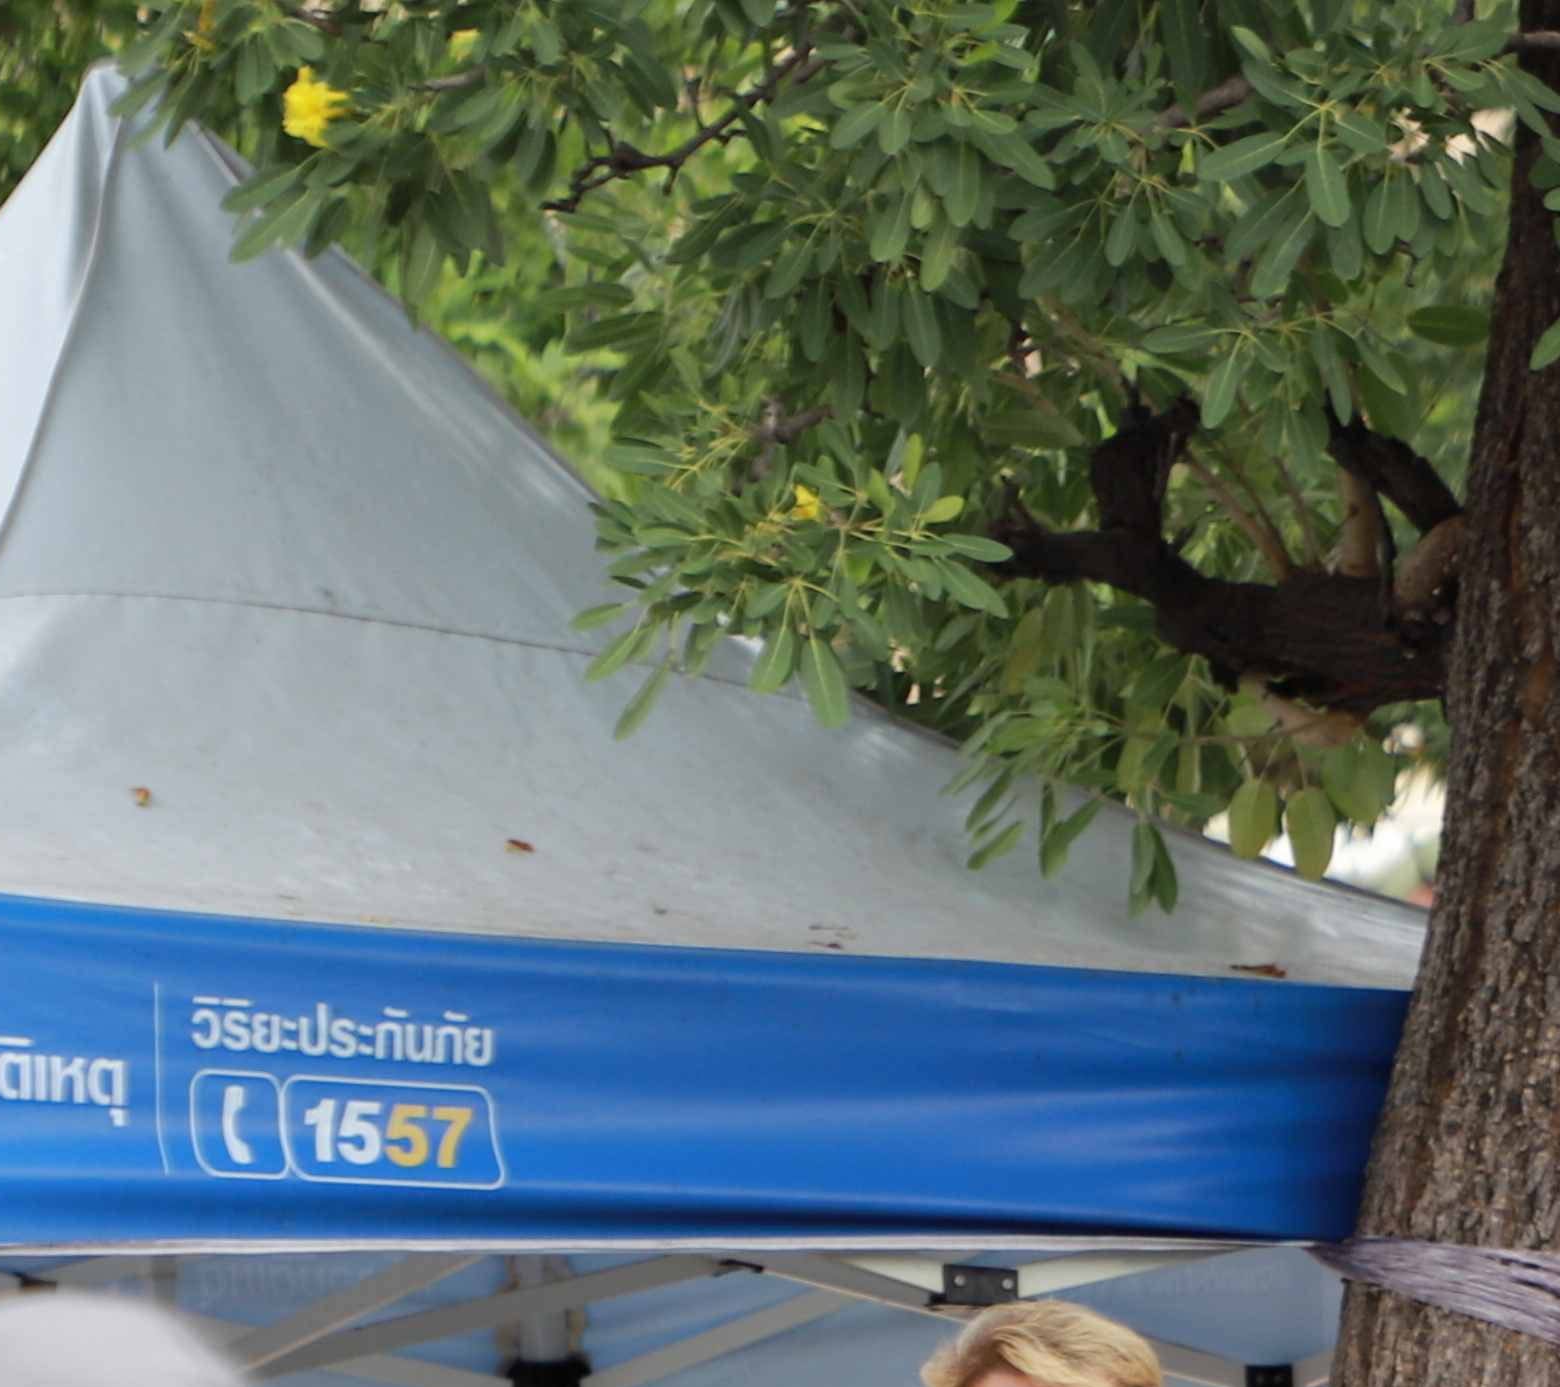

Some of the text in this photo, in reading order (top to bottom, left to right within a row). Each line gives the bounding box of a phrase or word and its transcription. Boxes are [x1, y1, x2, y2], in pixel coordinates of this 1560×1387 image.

[191, 996, 493, 1066] วิริยะประกันภัย
[303, 1098, 473, 1168] 1557
